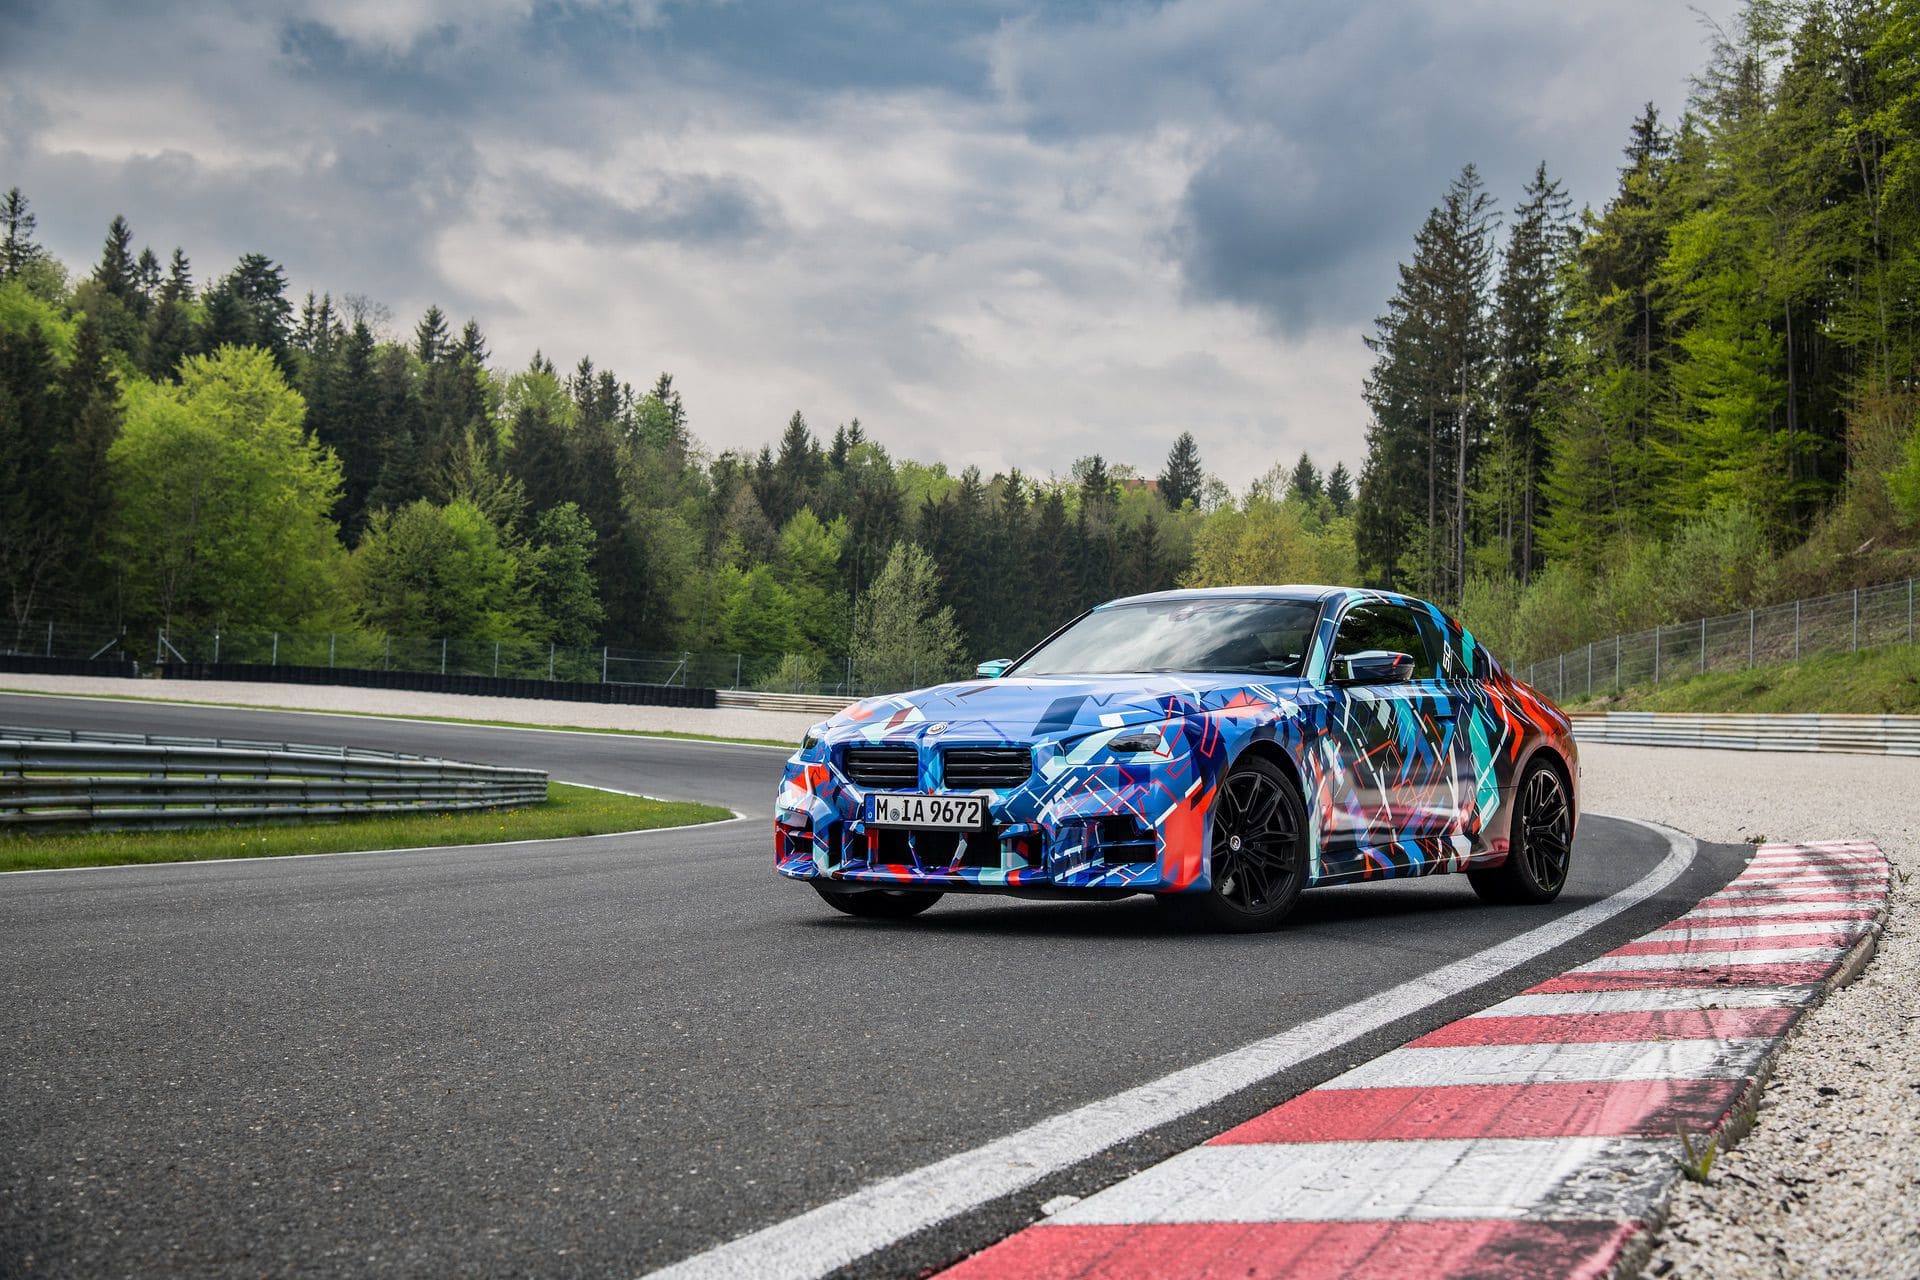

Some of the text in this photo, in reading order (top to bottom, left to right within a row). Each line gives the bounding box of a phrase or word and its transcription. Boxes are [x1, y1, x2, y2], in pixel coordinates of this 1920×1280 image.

[876, 798, 980, 824] M IA 9672
